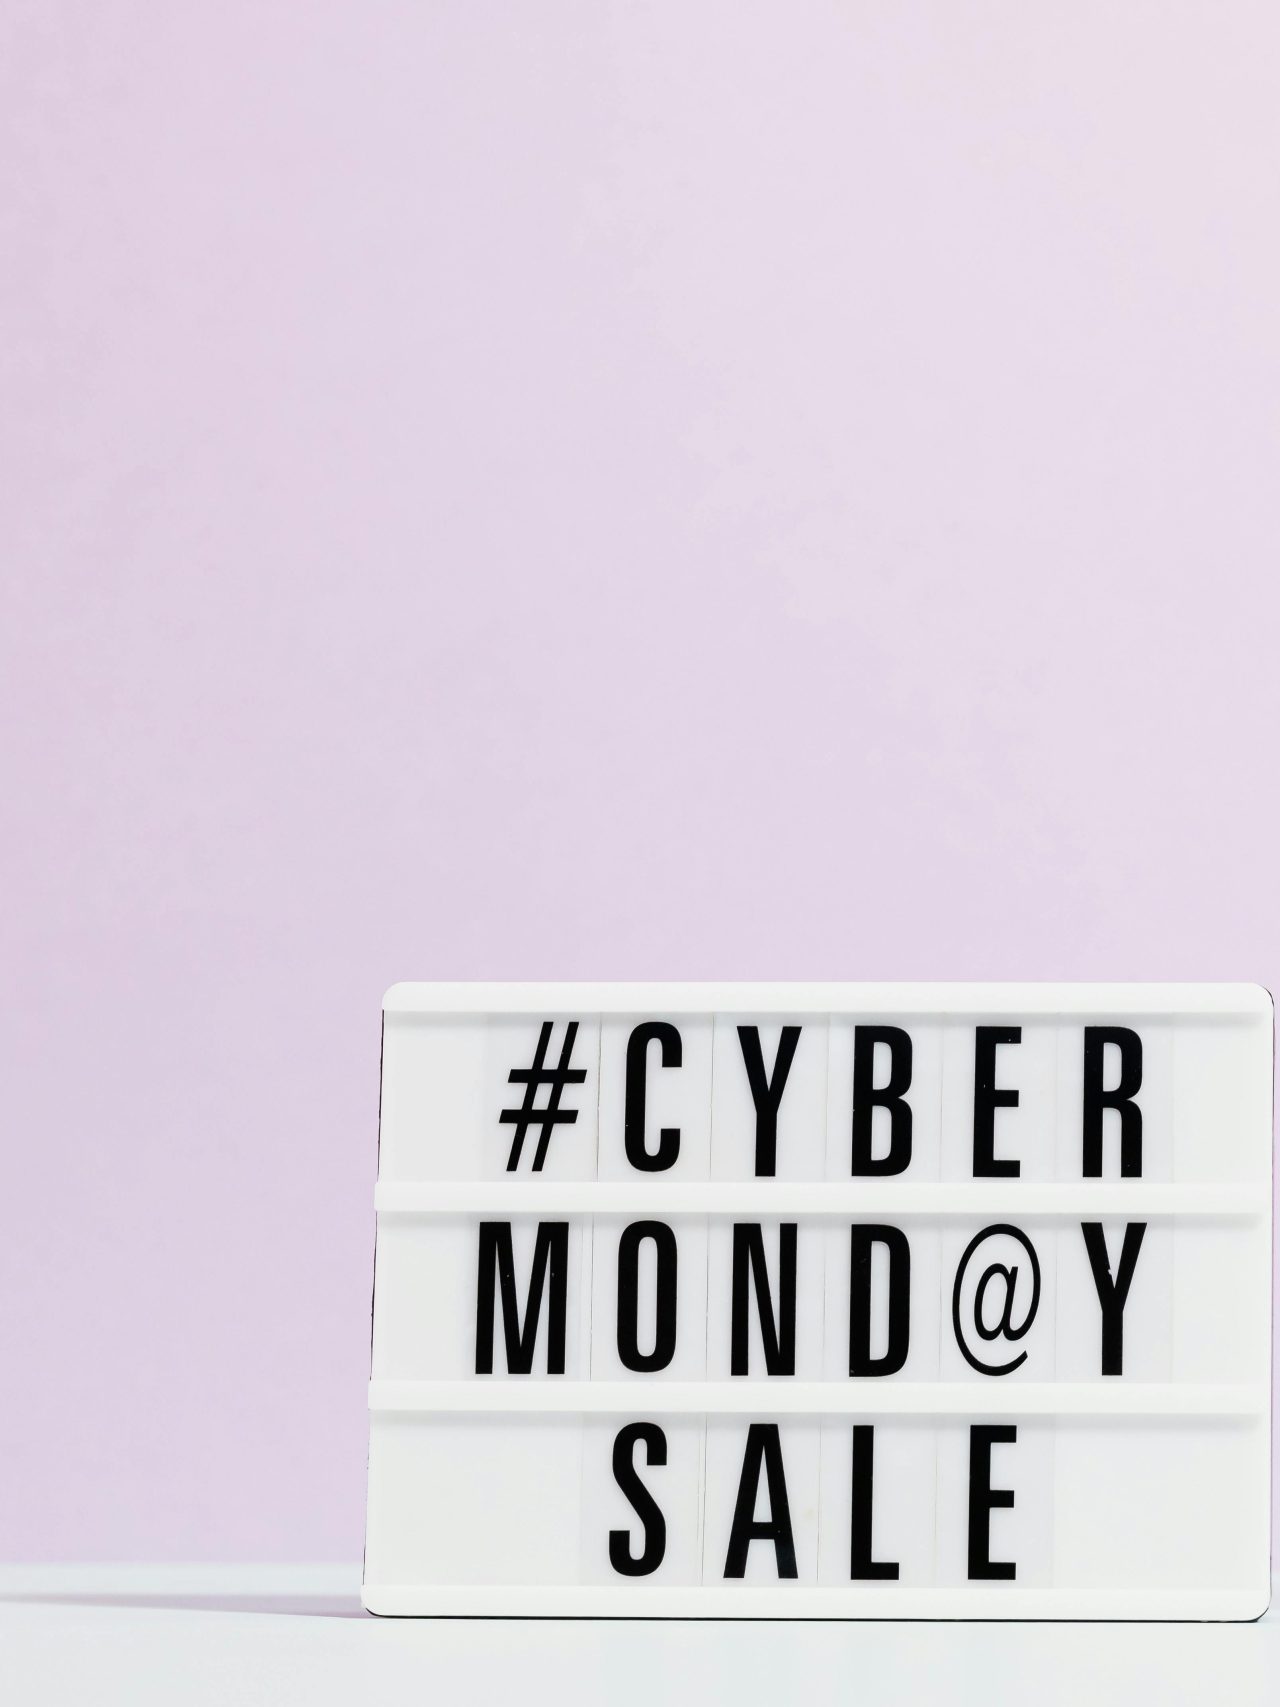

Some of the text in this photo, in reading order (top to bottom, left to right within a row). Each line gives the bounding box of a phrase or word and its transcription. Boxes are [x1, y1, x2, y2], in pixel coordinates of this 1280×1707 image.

[499, 1022, 1142, 1177] #CYBER
[475, 1220, 1147, 1377] MOND@Y
[609, 1422, 1017, 1580] SALE
